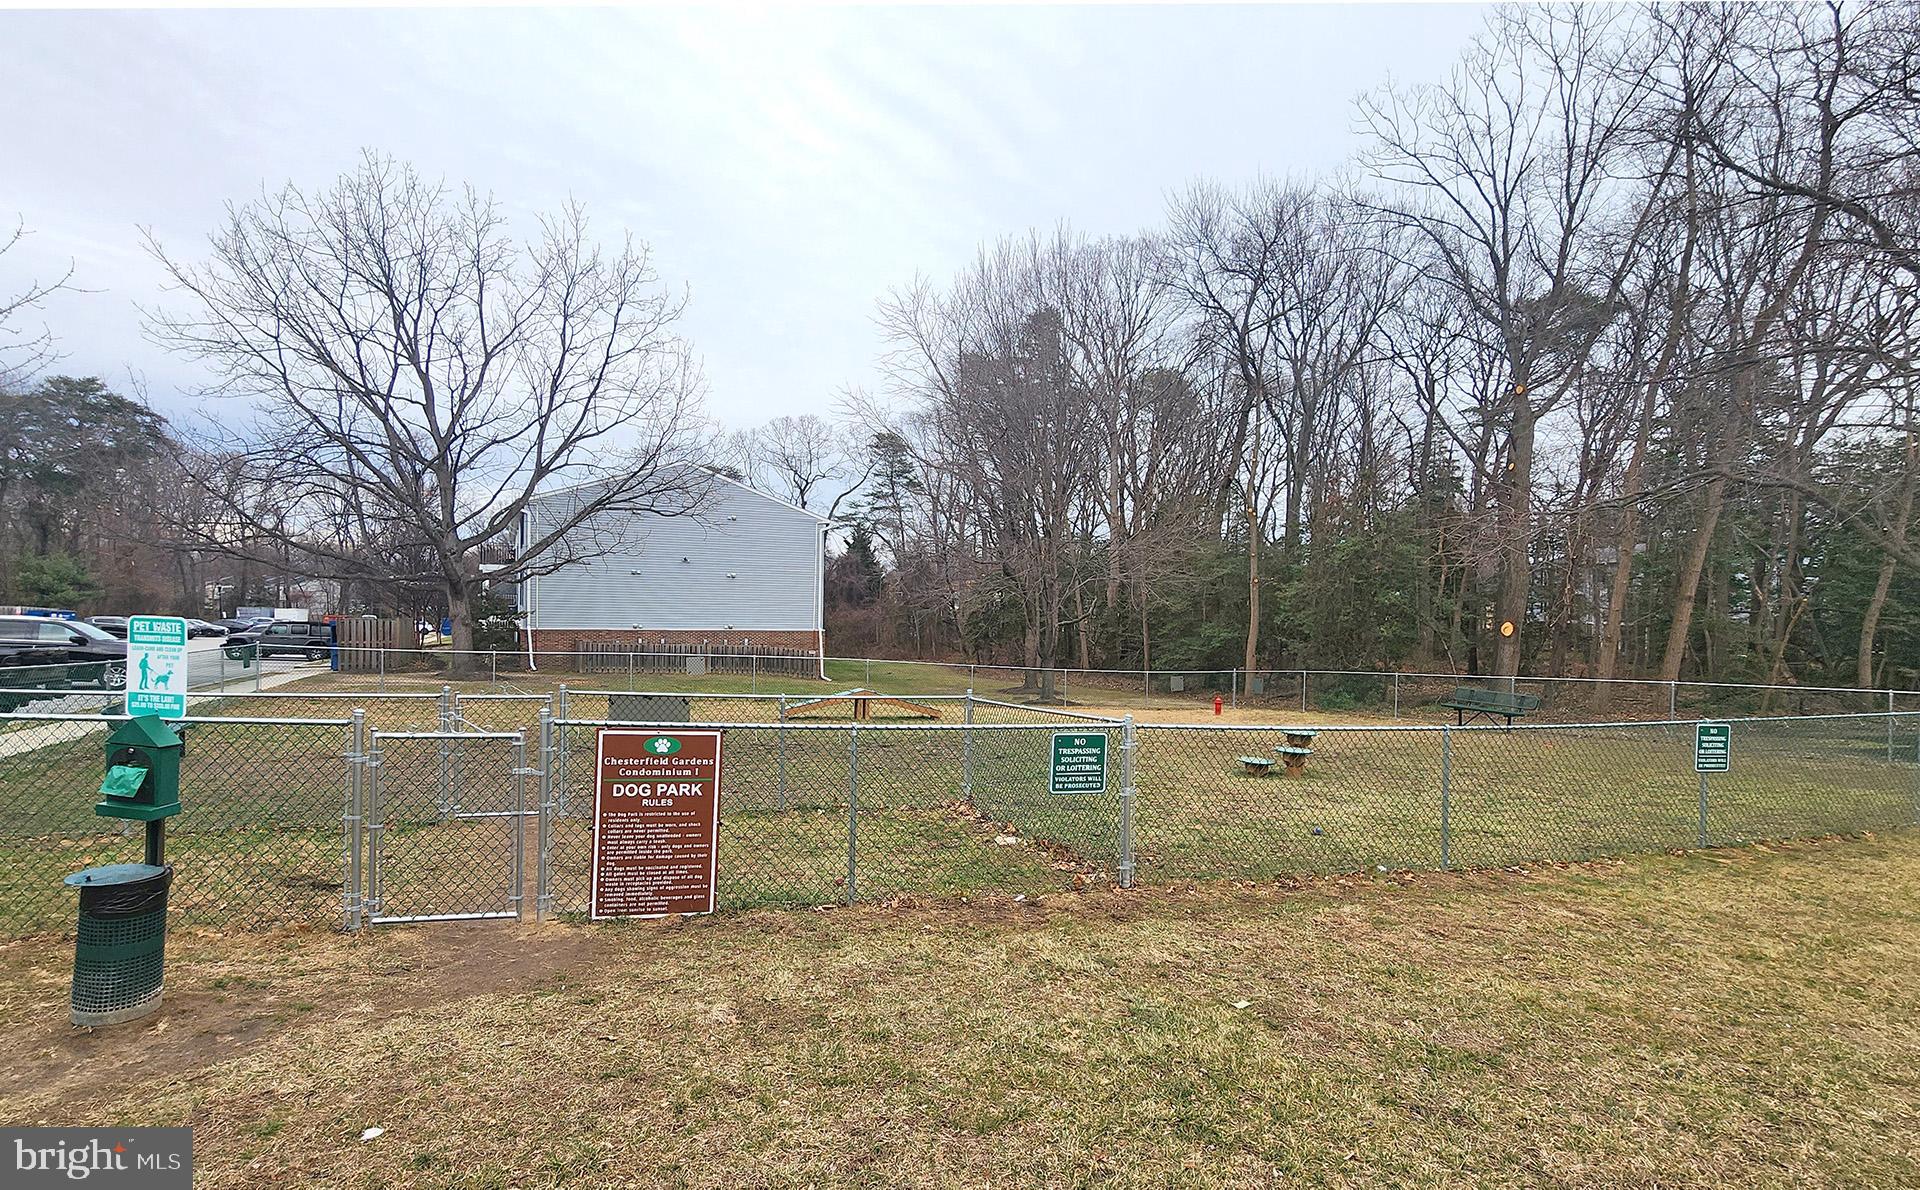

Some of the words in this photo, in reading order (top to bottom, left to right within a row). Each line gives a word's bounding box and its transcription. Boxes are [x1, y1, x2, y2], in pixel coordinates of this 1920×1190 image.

[133, 620, 151, 631] PET
[152, 622, 182, 632] WASTE
[150, 694, 160, 702] THE
[1074, 738, 1086, 746] NO
[604, 757, 668, 766] Chesterfield
[672, 757, 714, 766] Gardens
[619, 768, 692, 776] Condominium
[612, 784, 651, 797] DOG
[656, 784, 702, 796] PARK
